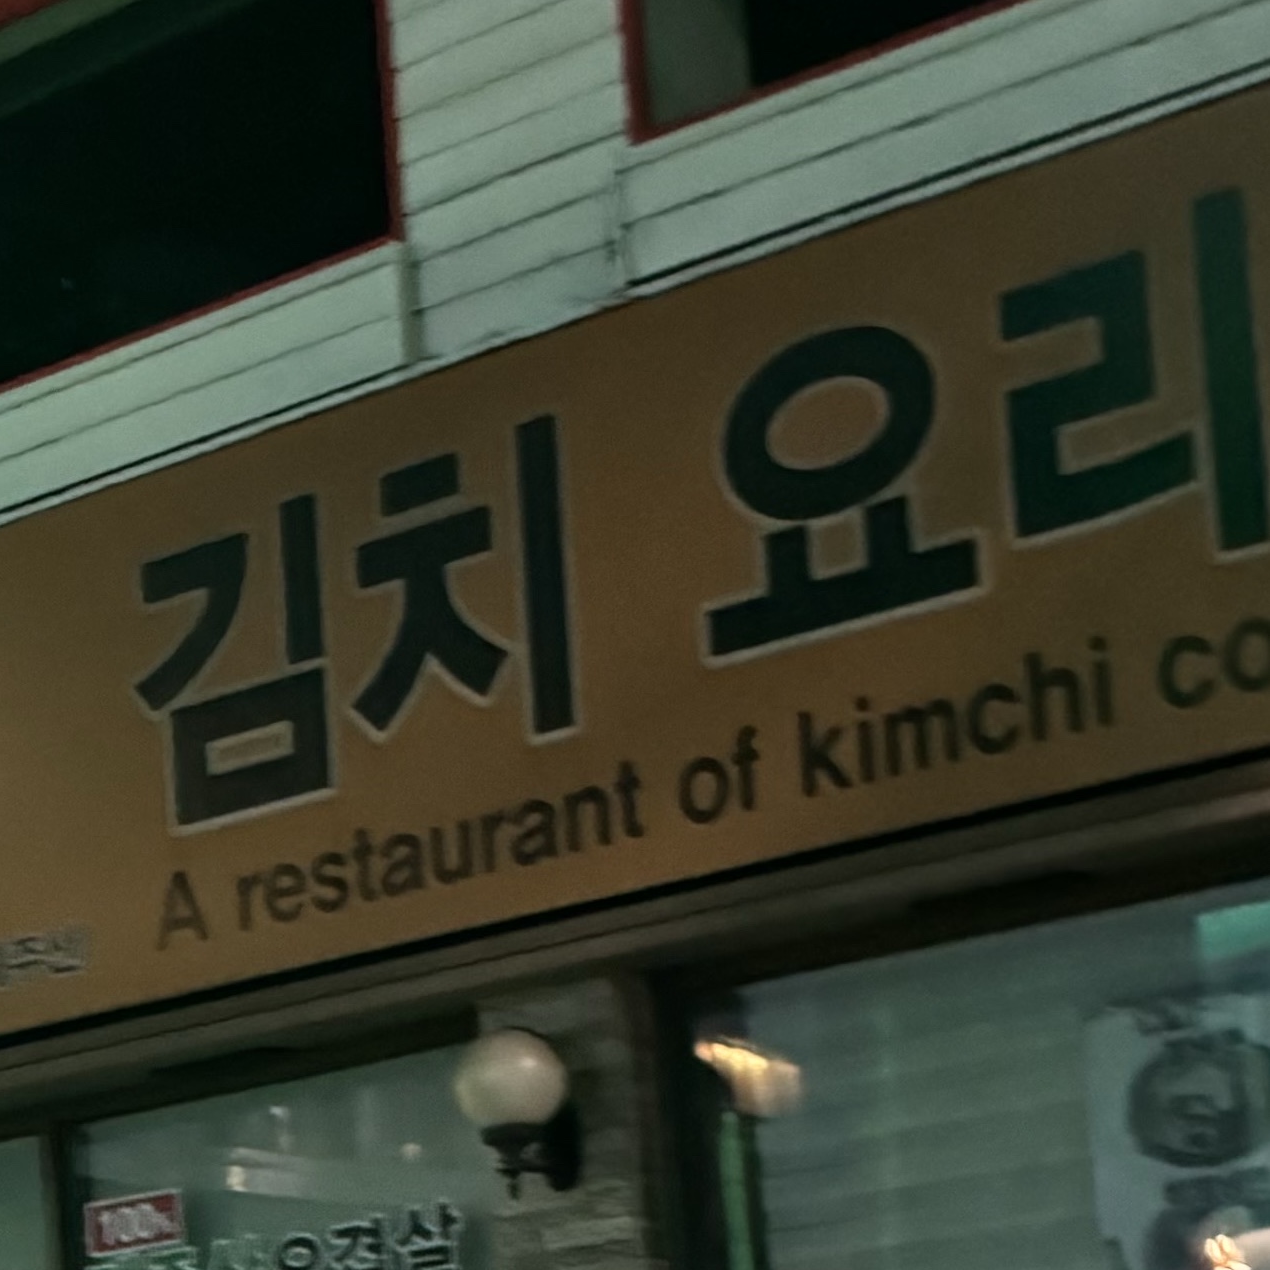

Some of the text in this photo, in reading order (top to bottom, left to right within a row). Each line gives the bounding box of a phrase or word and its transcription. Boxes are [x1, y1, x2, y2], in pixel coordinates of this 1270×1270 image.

[132, 412, 580, 832] 김치
[701, 186, 1270, 667] 요리
[157, 870, 210, 951] A
[236, 759, 645, 933] restaurant
[677, 724, 760, 825] of
[796, 634, 1115, 798] kimchi
